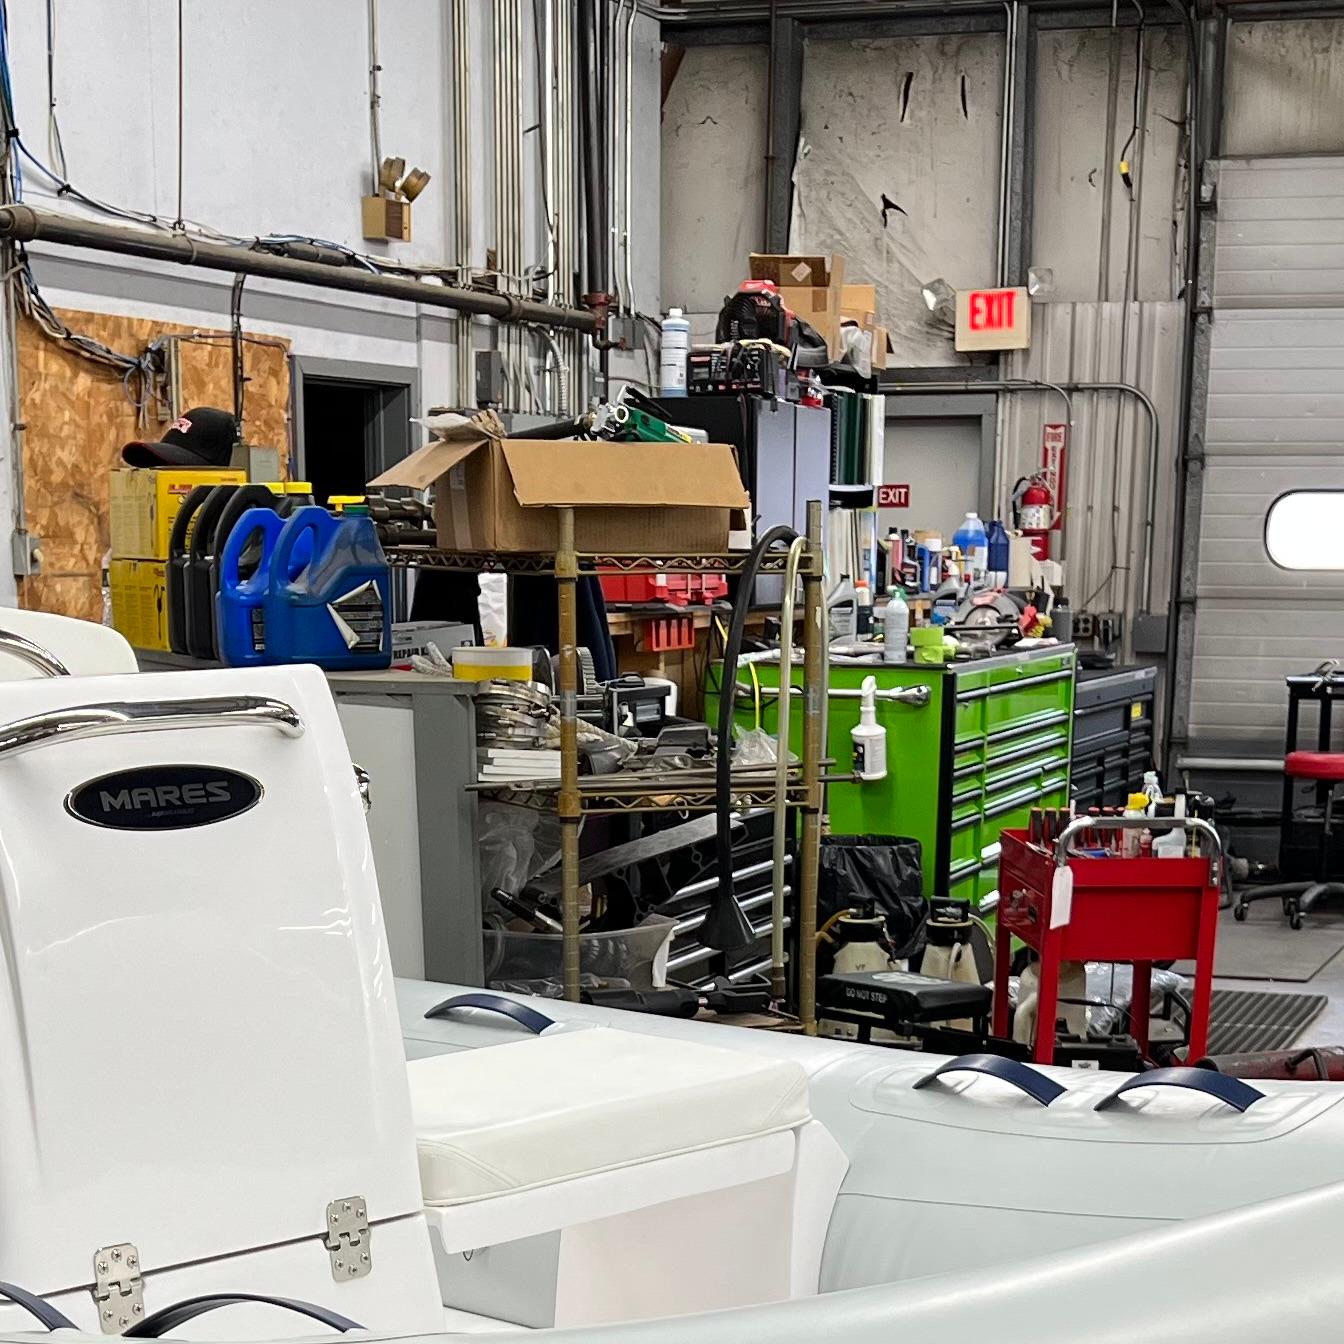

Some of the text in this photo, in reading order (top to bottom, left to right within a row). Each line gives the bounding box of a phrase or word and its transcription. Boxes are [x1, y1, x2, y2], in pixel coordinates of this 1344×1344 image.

[969, 290, 1017, 332] EXIT
[879, 487, 908, 504] EXIT
[99, 780, 232, 812] MARES
[870, 991, 888, 1004] STEP
